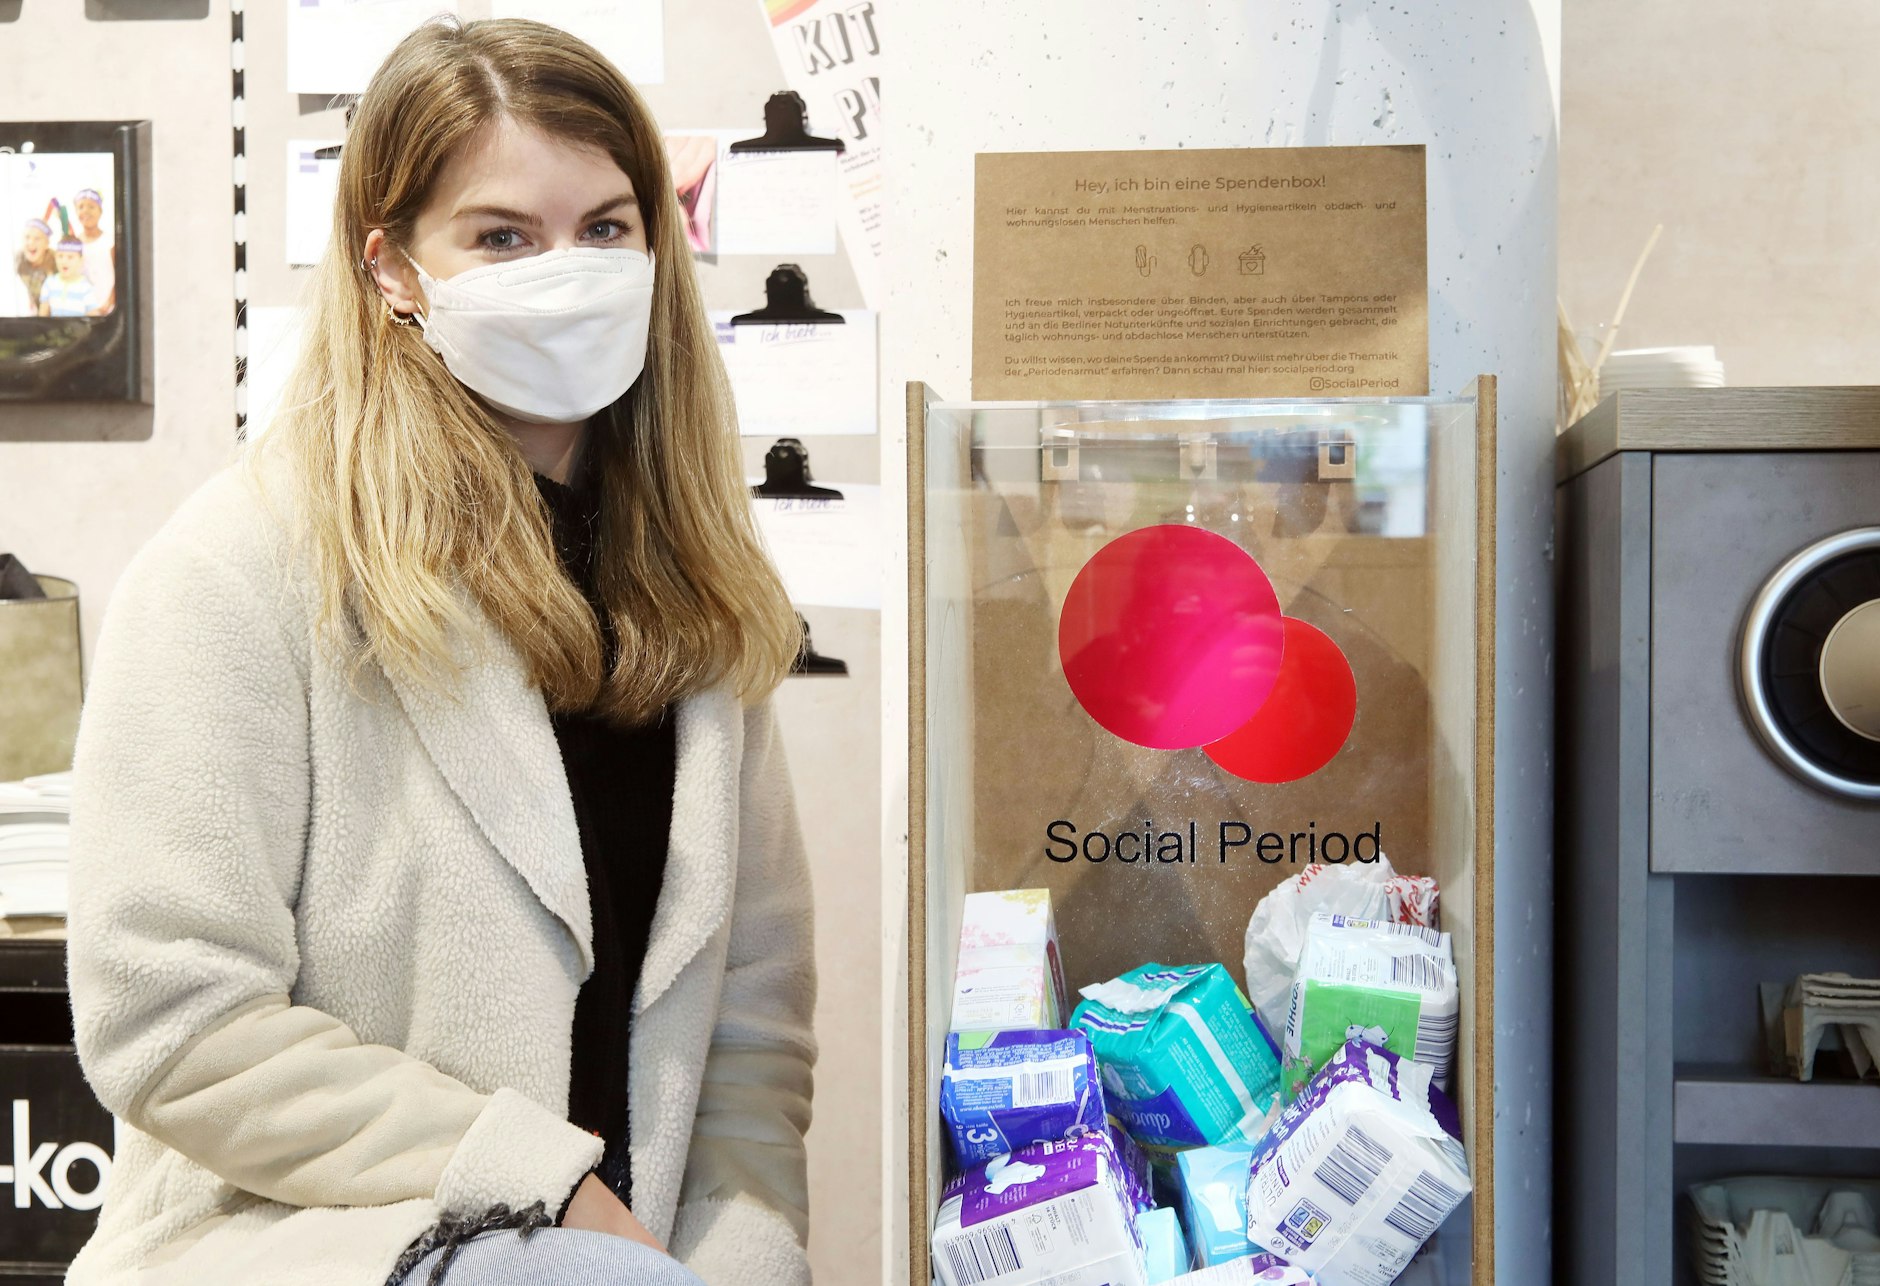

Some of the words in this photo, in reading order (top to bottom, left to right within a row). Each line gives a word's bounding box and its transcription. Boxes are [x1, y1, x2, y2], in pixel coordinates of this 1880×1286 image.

[1074, 178, 1111, 194] Hey,
[1114, 177, 1139, 191] ich
[1143, 177, 1170, 190] bin
[1175, 177, 1211, 190] eine
[1215, 175, 1326, 193] Spendenbox!
[1005, 207, 1027, 216] Hier
[1034, 206, 1069, 215] kannst
[1076, 206, 1091, 214] du
[1098, 206, 1117, 214] mit
[1123, 205, 1201, 214] Menstruations-
[1207, 204, 1229, 212] und
[1235, 202, 1317, 214] Hygieneartikeln
[1324, 201, 1369, 210] obdach-
[1374, 201, 1397, 210] und
[1005, 218, 1086, 228] wohnungslosen
[1088, 216, 1141, 226] Menschen
[1143, 216, 1178, 225] helfen.
[1005, 298, 1021, 307] Ich
[1025, 298, 1053, 306] freue
[1057, 297, 1083, 306] mich
[1087, 296, 1159, 306] insbesondere
[1160, 296, 1184, 305] über
[1188, 295, 1229, 305] Binden,
[1233, 295, 1257, 304] aber
[1261, 295, 1287, 304] auch
[1291, 294, 1316, 303] über
[1319, 294, 1369, 304] Tampons
[1372, 293, 1397, 302] oder
[1004, 309, 1081, 320] Hygieneartikel,
[1083, 309, 1128, 318] verpackt
[1130, 308, 1154, 317] oder
[1157, 307, 1217, 318] ungeöffnet.
[1220, 307, 1244, 316] Eure
[1247, 306, 1294, 316] Spenden
[1295, 306, 1335, 315] werden
[1338, 305, 1398, 316] gesammelt
[1005, 321, 1026, 330] und
[1028, 322, 1041, 330] an
[1043, 320, 1059, 329] die
[1061, 320, 1101, 329] Berliner
[1104, 319, 1184, 329] Notunterkünfte
[1186, 319, 1207, 328] und
[1209, 318, 1250, 327] sozialen
[1252, 318, 1327, 329] Einrichtungen
[1328, 317, 1379, 328] gebracht,
[1381, 317, 1398, 325] die
[1004, 332, 1040, 343] täglich
[1041, 333, 1099, 343] wohnungs-
[1102, 332, 1123, 340] und
[1124, 331, 1183, 340] obdachlose
[1186, 330, 1239, 339] Menschen
[1241, 330, 1310, 339] unterstützen.
[1004, 356, 1020, 364] Du
[1021, 355, 1047, 364] willst
[1048, 356, 1086, 364] wissen,
[1086, 356, 1103, 364] wo
[1103, 355, 1132, 363] deine
[1133, 354, 1173, 364] Spende
[1173, 353, 1230, 363] ankommt?
[1231, 353, 1247, 362] Du
[1247, 352, 1274, 362] willst
[1276, 353, 1304, 362] mehr
[1305, 352, 1329, 361] über
[1331, 352, 1347, 361] die
[1349, 351, 1398, 361] Thematik
[1003, 368, 1022, 376] der
[1023, 367, 1109, 377] „Periodenarmut“
[1111, 366, 1161, 375] erfahren?
[1162, 365, 1191, 374] Dann
[1192, 366, 1224, 374] schau
[1225, 365, 1246, 374] mal
[1247, 364, 1271, 374] hier:
[1272, 364, 1355, 375] socialperiod.org
[1322, 377, 1400, 389] SocialPeriod
[1045, 820, 1195, 863] Social
[1220, 820, 1381, 863] Period
[966, 1128, 998, 1144] 3
[0, 1099, 119, 1211] -ko
